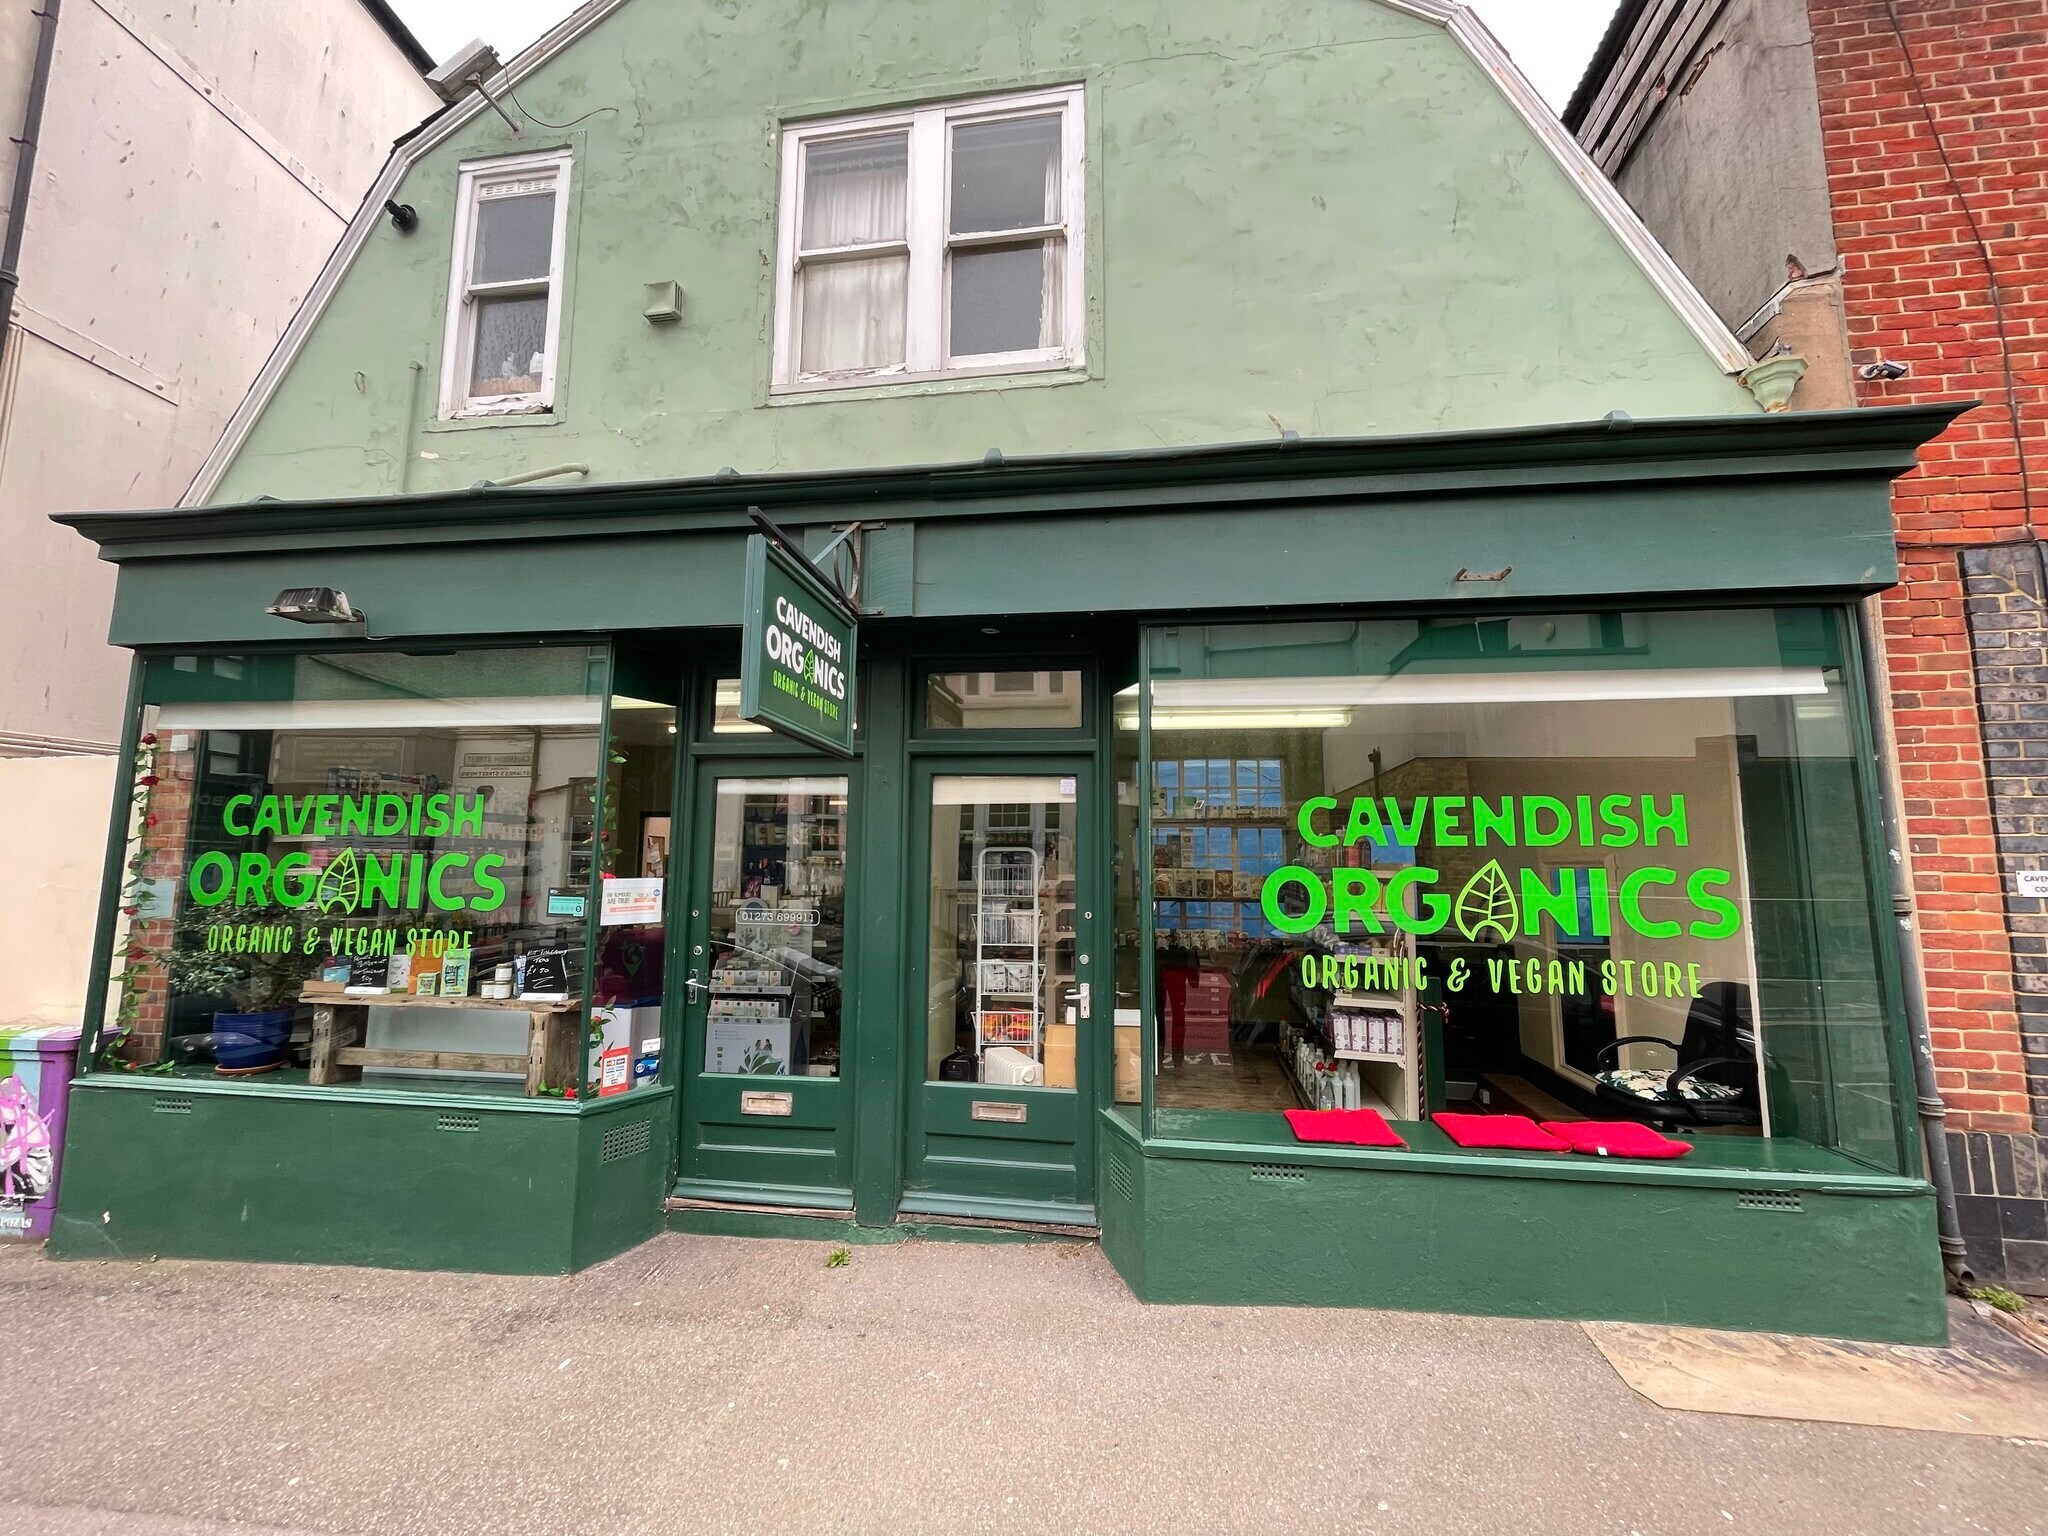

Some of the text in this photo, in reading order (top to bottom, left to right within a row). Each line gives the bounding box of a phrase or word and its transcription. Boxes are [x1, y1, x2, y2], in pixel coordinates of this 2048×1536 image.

[776, 596, 841, 664] CAVENDISH
[773, 670, 839, 721] ORGANIC & VEGAN STORE
[223, 793, 485, 837] CAVENDISH
[1297, 794, 1689, 848] CAVENDISH
[742, 912, 814, 923] 01273 699911
[207, 925, 473, 958] ORGANIC & VEGAN STORE
[1301, 955, 1704, 999] ORGANIC & VEGAN STORE
